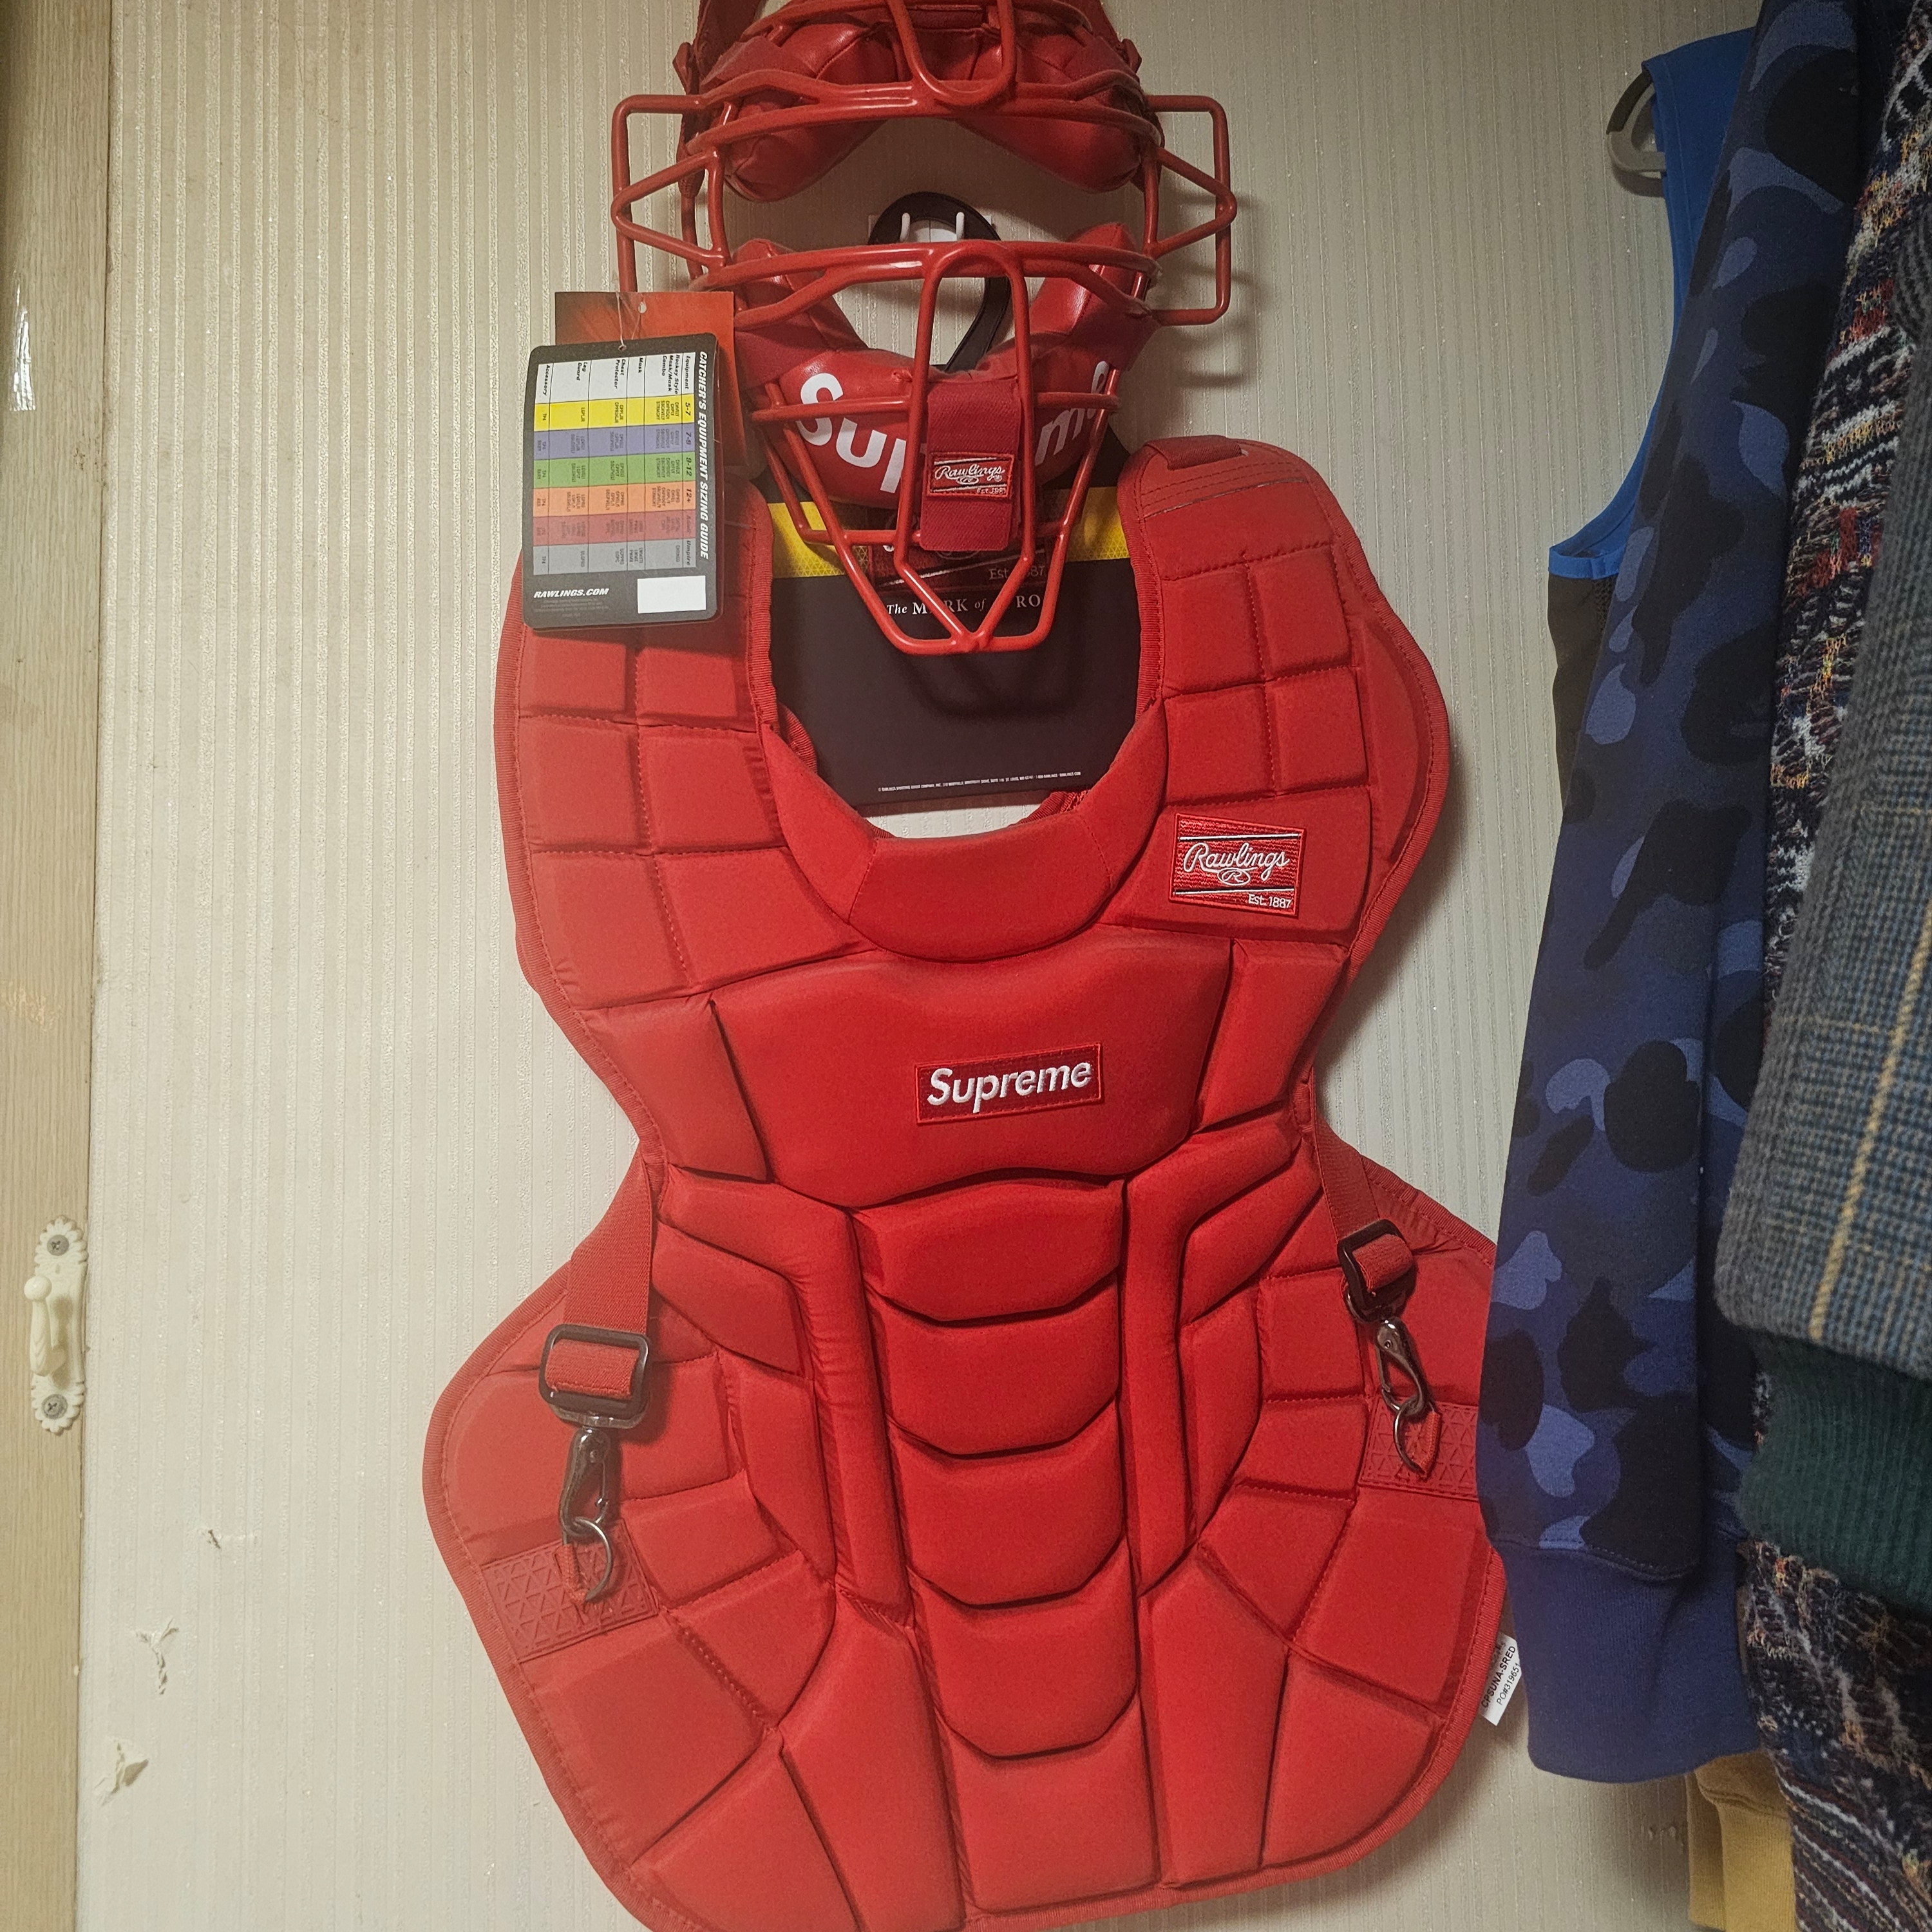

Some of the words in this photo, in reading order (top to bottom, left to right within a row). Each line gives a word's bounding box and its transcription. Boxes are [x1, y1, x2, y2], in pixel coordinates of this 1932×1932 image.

[699, 352, 707, 410] CATCHER'S
[699, 412, 708, 480] EQUIPMENT
[935, 464, 1005, 482] Rawlings
[700, 482, 708, 522] SIZING
[700, 523, 708, 560] GUIDE
[533, 588, 609, 598] RAWLINGS.COM
[886, 604, 907, 614] The
[912, 598, 968, 615] MRK
[974, 598, 987, 611] of
[1016, 594, 1041, 608] RO
[1184, 842, 1291, 882] Rawlings
[1248, 893, 1267, 905] Est.
[1269, 896, 1292, 909] 1887
[927, 1061, 1092, 1113] Supreme
[1481, 1646, 1516, 1709] CPSUNA-SRED
[1496, 1662, 1520, 1705] PO#319651
